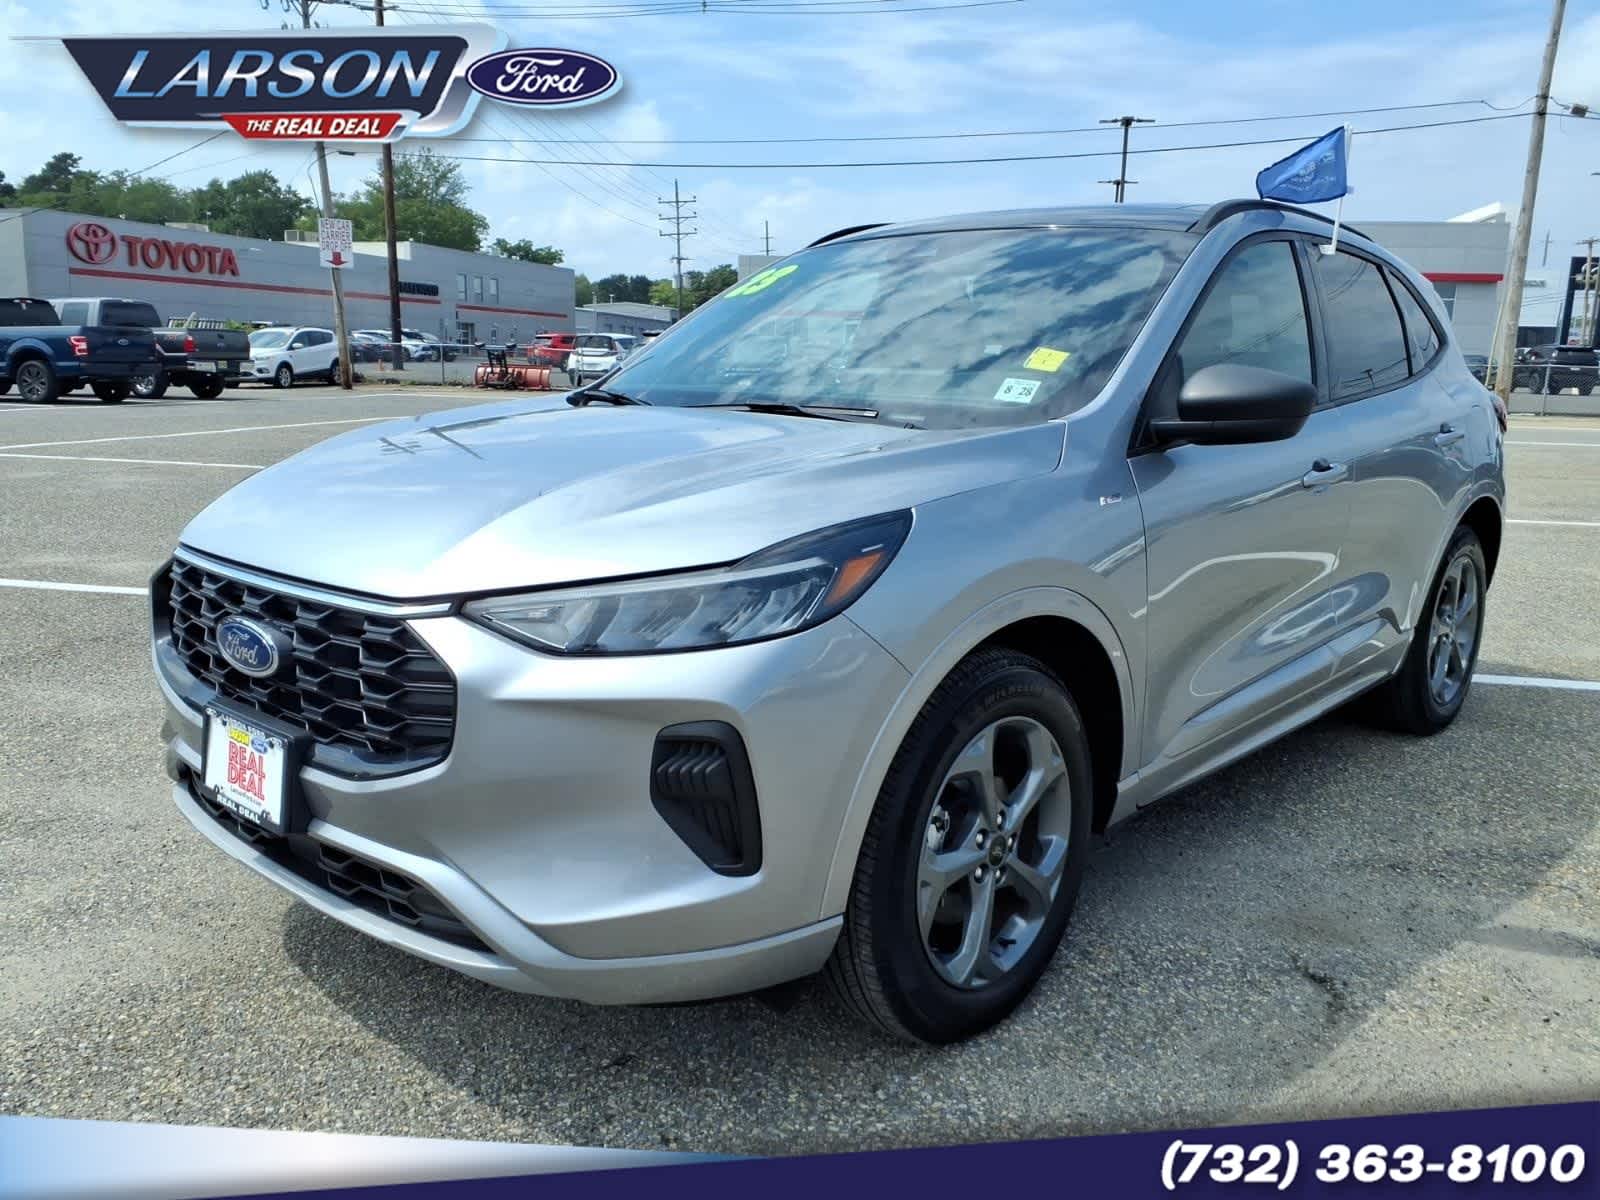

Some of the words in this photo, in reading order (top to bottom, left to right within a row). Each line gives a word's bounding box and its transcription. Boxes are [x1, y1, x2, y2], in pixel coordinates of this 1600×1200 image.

[321, 230, 351, 241] CARRIER
[337, 220, 350, 231] CAR
[120, 234, 240, 277] TOYOTA
[321, 240, 338, 250] DROP
[224, 628, 258, 666] Ford
[228, 740, 266, 779] REAL
[227, 763, 265, 801] DEAL
